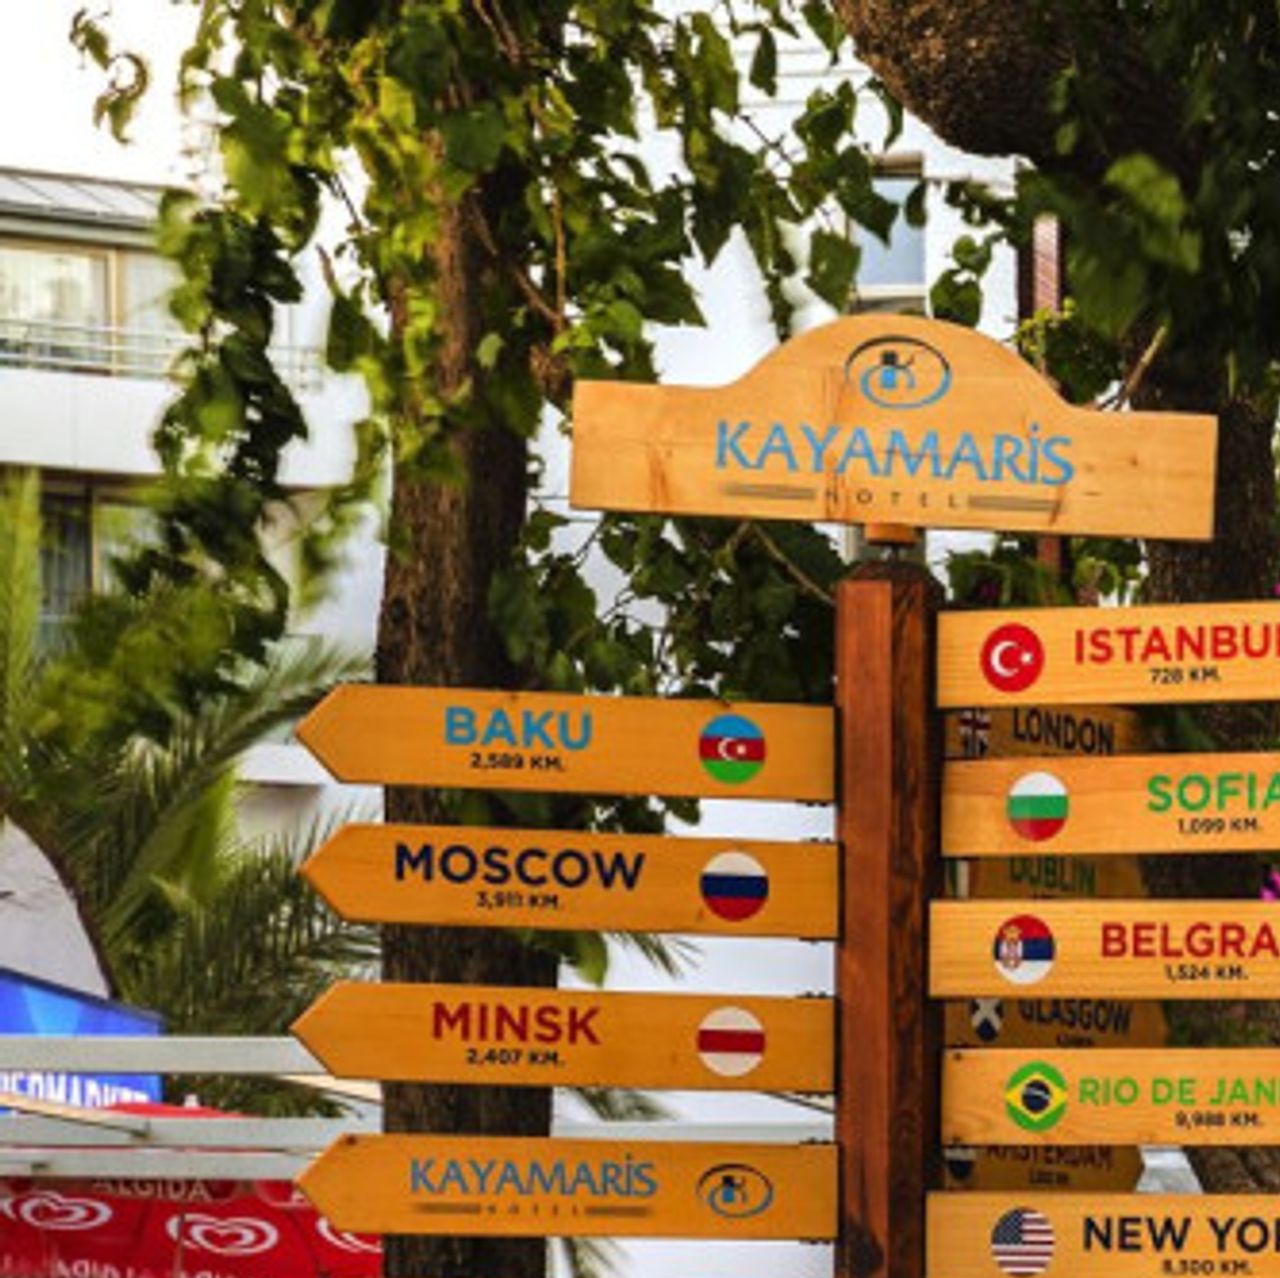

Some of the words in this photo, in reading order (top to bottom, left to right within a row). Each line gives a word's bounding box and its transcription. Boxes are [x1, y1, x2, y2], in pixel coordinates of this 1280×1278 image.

[825, 488, 958, 510] HOTEL
[444, 706, 593, 751] BAKU
[1012, 706, 1115, 756] LONDON
[394, 843, 646, 891] MOSCOW
[1009, 856, 1096, 897] DUBLIN
[432, 1001, 601, 1046] MINSK
[1018, 998, 1132, 1036] GLASGOW
[1078, 1076, 1140, 1107] RIO
[1151, 1076, 1197, 1107] DE
[1083, 1216, 1192, 1252] NEW
